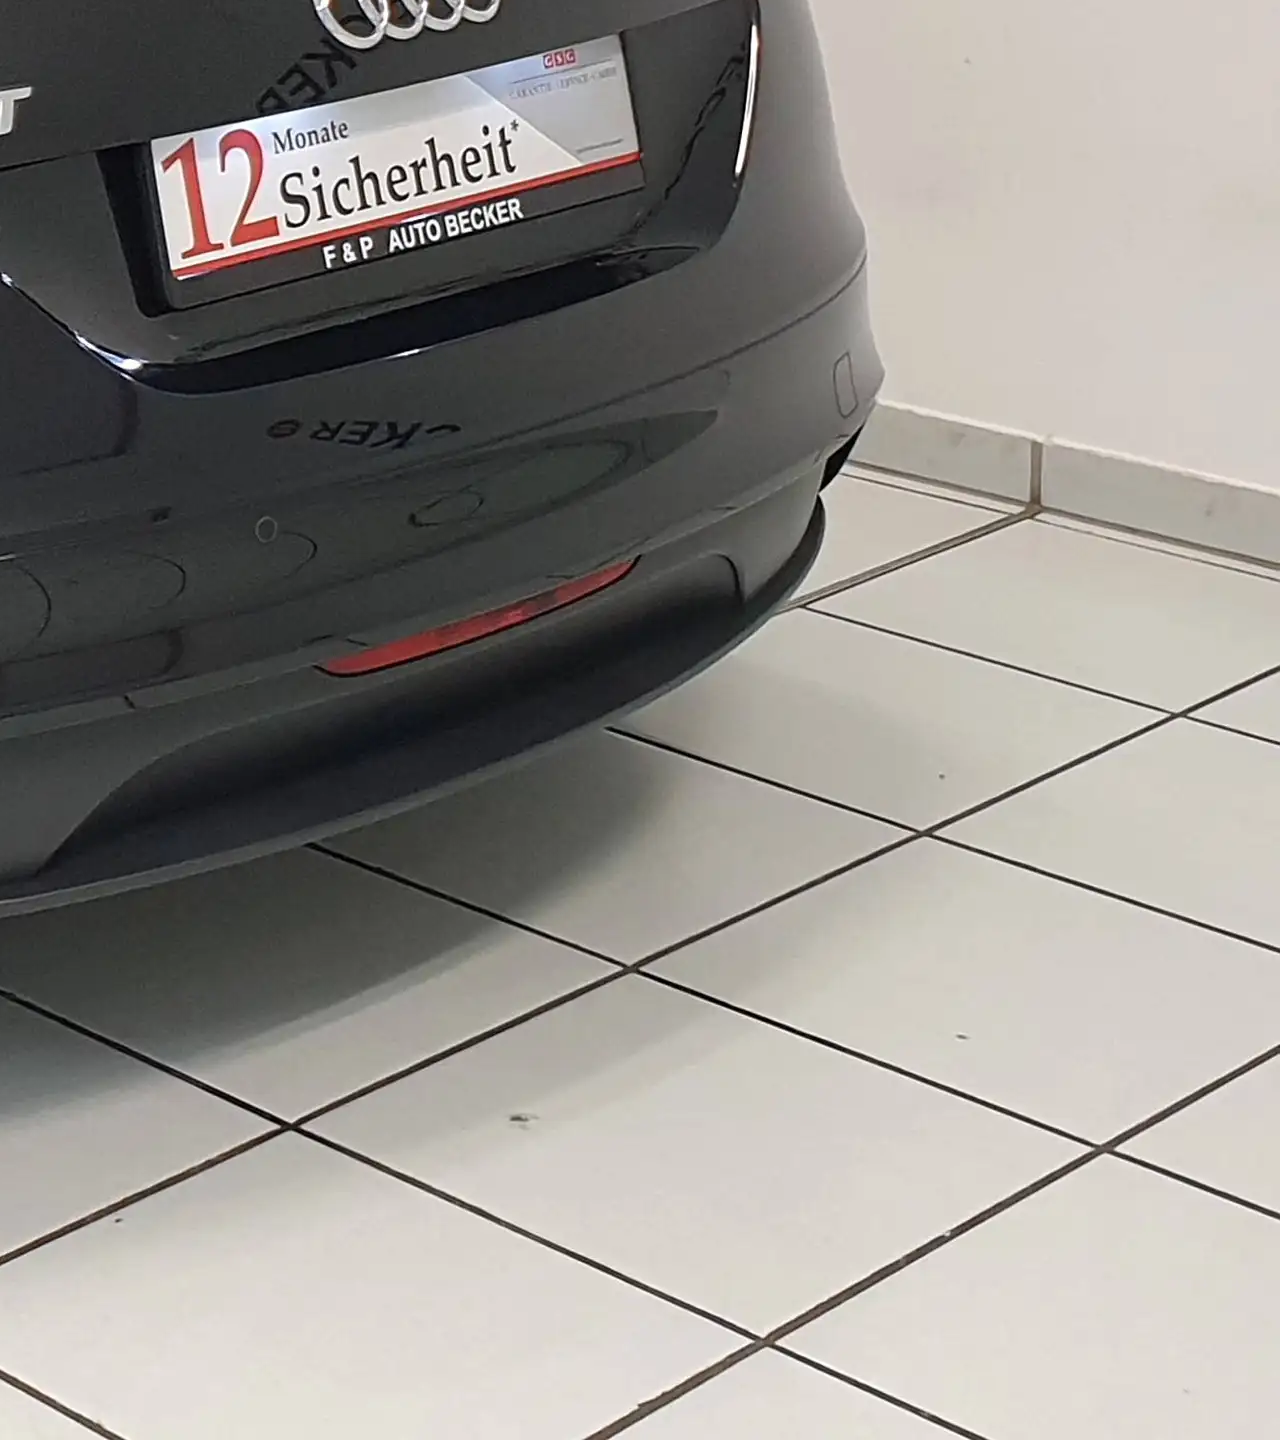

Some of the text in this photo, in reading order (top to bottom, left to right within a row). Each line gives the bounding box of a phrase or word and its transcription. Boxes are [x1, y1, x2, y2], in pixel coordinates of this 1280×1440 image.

[271, 119, 349, 155] Monate
[161, 128, 280, 260] 12
[388, 219, 441, 254] AUTO
[444, 197, 525, 238] BECKER
